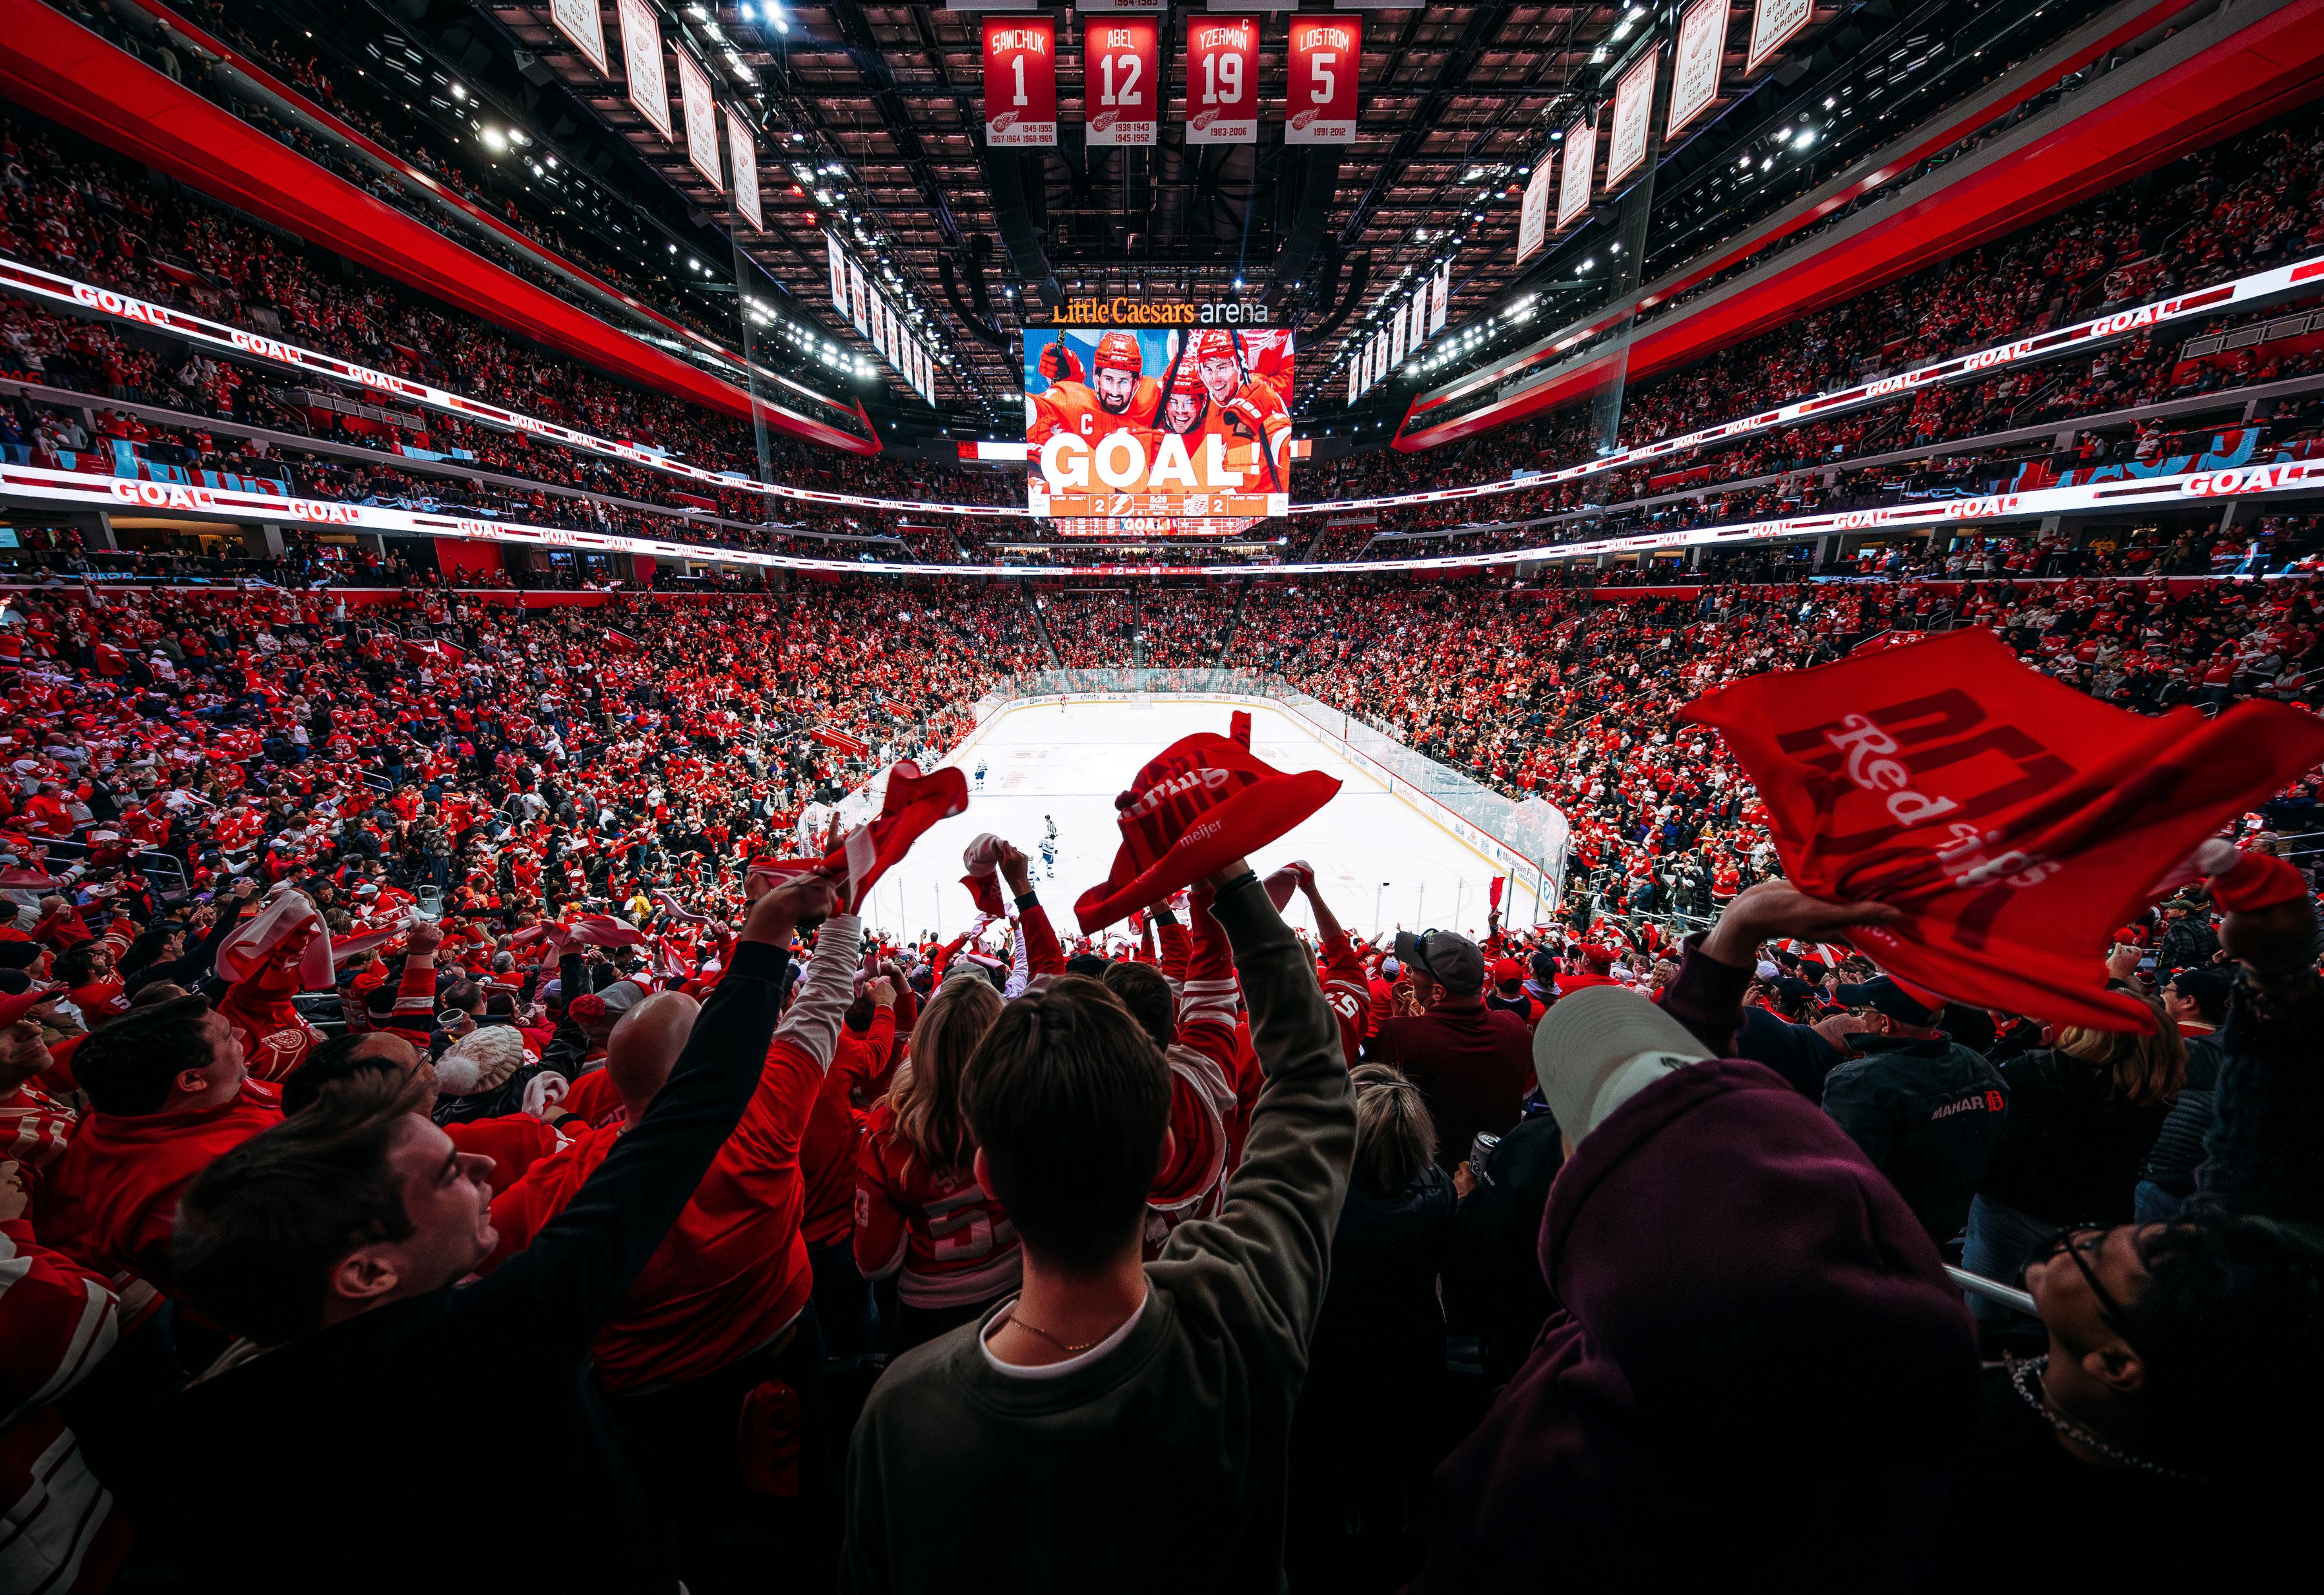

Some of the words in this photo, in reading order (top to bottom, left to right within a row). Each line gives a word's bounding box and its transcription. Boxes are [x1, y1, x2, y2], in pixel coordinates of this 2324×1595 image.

[570, 4, 584, 23] CUP
[624, 3, 635, 19] RED
[638, 19, 655, 43] WINGS
[1241, 19, 1249, 31] C
[1685, 25, 1698, 42] RED
[1700, 2, 1723, 27] WINGS
[1775, 3, 1791, 23] CUP
[558, 4, 598, 52] CHAMPIONS
[1199, 26, 1247, 51] YZERMAN
[1757, 3, 1805, 50] CHAMPIONS
[992, 29, 1046, 56] SAWCHUK
[1106, 29, 1135, 50] ABEL
[1300, 28, 1349, 53] LIDSTROM
[634, 50, 657, 80] 1997-98
[1684, 48, 1712, 79] 1942-43
[635, 63, 658, 94] STANLEY
[643, 83, 654, 97] CUP
[686, 65, 705, 93] DETROIT
[1012, 56, 1028, 106] 1
[1101, 55, 1142, 106] 12
[1202, 53, 1243, 104] 19
[1310, 53, 1335, 104] 5
[1620, 91, 1631, 105] RED
[1631, 72, 1650, 96] WINGS
[1625, 64, 1647, 92] DETROIT
[1682, 62, 1711, 93] STANLEY
[1687, 81, 1702, 99] CUP
[635, 85, 665, 123] CHAMPIONS
[1674, 84, 1712, 121] CHAMPIONS
[693, 127, 712, 152] STANLEY
[991, 134, 1021, 143] 1957-1964
[1023, 134, 1053, 143] 1968-1969
[1022, 125, 1053, 133] 1949-1955
[1115, 123, 1149, 132] 1938-1943
[1115, 134, 1149, 143] 1945-1952
[1210, 128, 1247, 136] 1983-2006
[1314, 128, 1346, 136] 1991-2012
[1618, 127, 1641, 151] STANLEY
[693, 146, 717, 176] CHAMPIONS
[700, 144, 708, 156] CUP
[1612, 144, 1642, 175] CHAMPIONS
[1622, 144, 1633, 156] CUP
[1565, 175, 1586, 197] STANLEY
[1569, 190, 1579, 201] CUP
[1561, 192, 1586, 218] CHAMPIONS
[1521, 231, 1542, 254] CHAMPIONS
[834, 265, 843, 300] 11
[72, 282, 170, 325] GOAL!
[854, 289, 864, 321] 15
[1052, 297, 1109, 323] Little
[1112, 297, 1194, 323] Caesars
[1200, 303, 1268, 323] arena
[873, 309, 882, 340] 16
[1415, 310, 1420, 336] 1
[2090, 300, 2182, 338] GOAL!
[231, 330, 303, 363] GOAL!
[1395, 329, 1402, 354] 2
[1379, 345, 1384, 368] 3
[1964, 341, 2033, 372] GOAL!
[347, 364, 403, 391] GOAL!
[1351, 372, 1357, 392] 10
[1364, 359, 1369, 380] 4
[1865, 371, 1921, 398] GOAL!
[509, 413, 545, 433] GOAL!
[1081, 414, 1093, 435] C
[1726, 417, 1761, 434] GOAL!
[567, 431, 597, 449] GOAL!
[1673, 433, 1703, 448] GOAL!
[615, 445, 640, 461] GOAL!
[1040, 432, 1261, 489] GOAL!
[1629, 447, 1655, 461] GOAL!
[2181, 463, 2309, 497] GOAL!
[110, 478, 215, 509] GOAL!
[1094, 499, 1105, 513] 2
[1213, 499, 1223, 513] 2
[289, 498, 361, 524] GOAL!
[1944, 495, 2022, 518] GOAL!
[456, 518, 505, 538] GOAL!
[1124, 518, 1170, 531] GOAL!
[1749, 520, 1793, 537] GOAL!
[1833, 510, 1891, 529] GOAL!
[540, 529, 577, 544] GOAL!
[334, 742, 352, 755] 53
[1825, 713, 1959, 826] Red
[1179, 818, 1223, 848] meijer
[1454, 824, 1465, 837] Blue
[1503, 850, 1527, 873] Michigan
[1527, 866, 1538, 882] First
